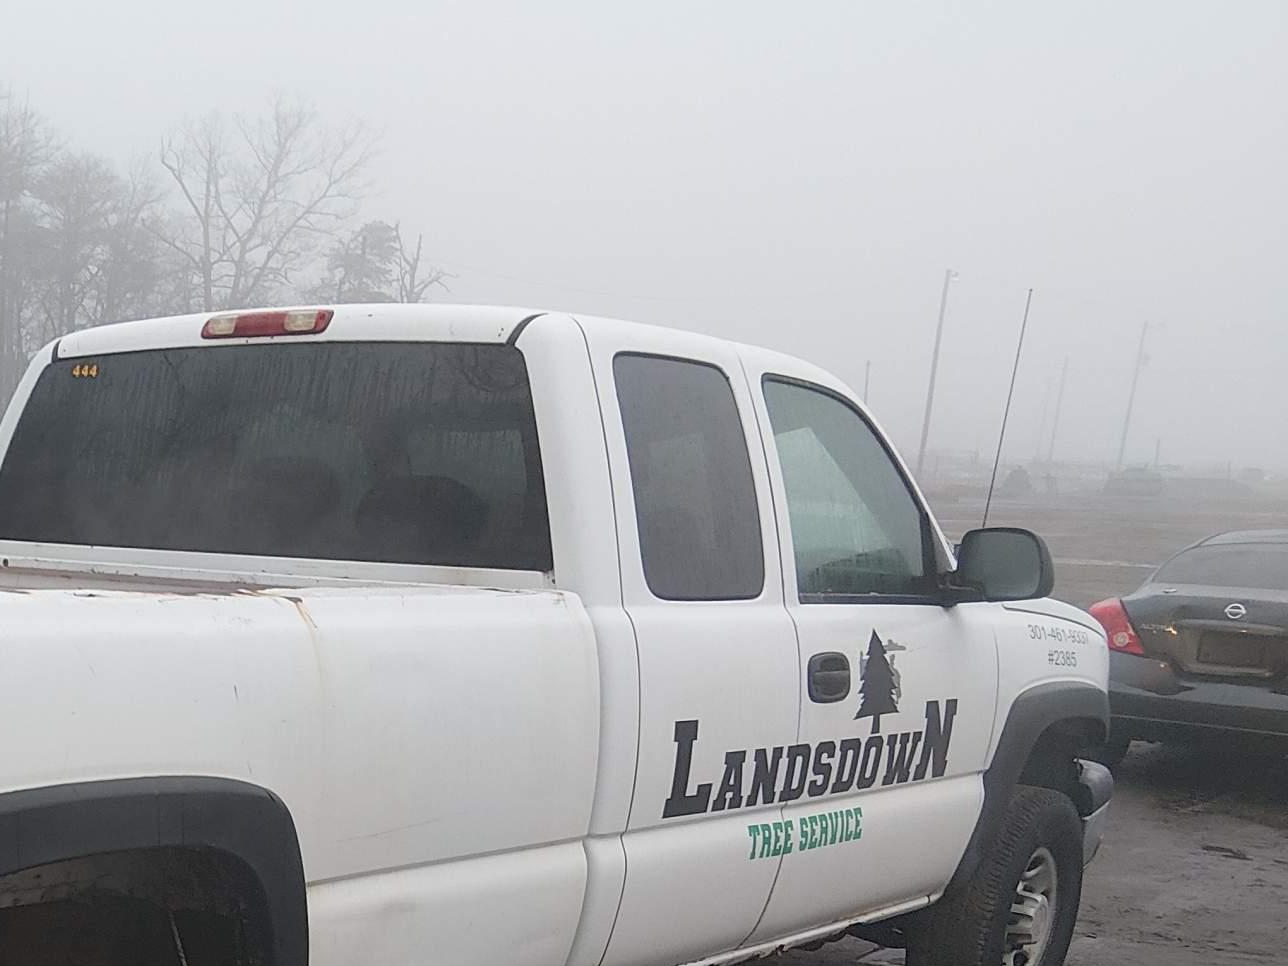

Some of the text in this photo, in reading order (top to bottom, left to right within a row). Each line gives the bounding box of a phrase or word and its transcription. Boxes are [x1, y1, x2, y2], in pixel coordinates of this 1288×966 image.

[72, 364, 97, 378] 444
[1048, 649, 1078, 667] #2385
[662, 698, 959, 819] LANDSDOWN
[748, 806, 864, 860] TREE SERVICE
